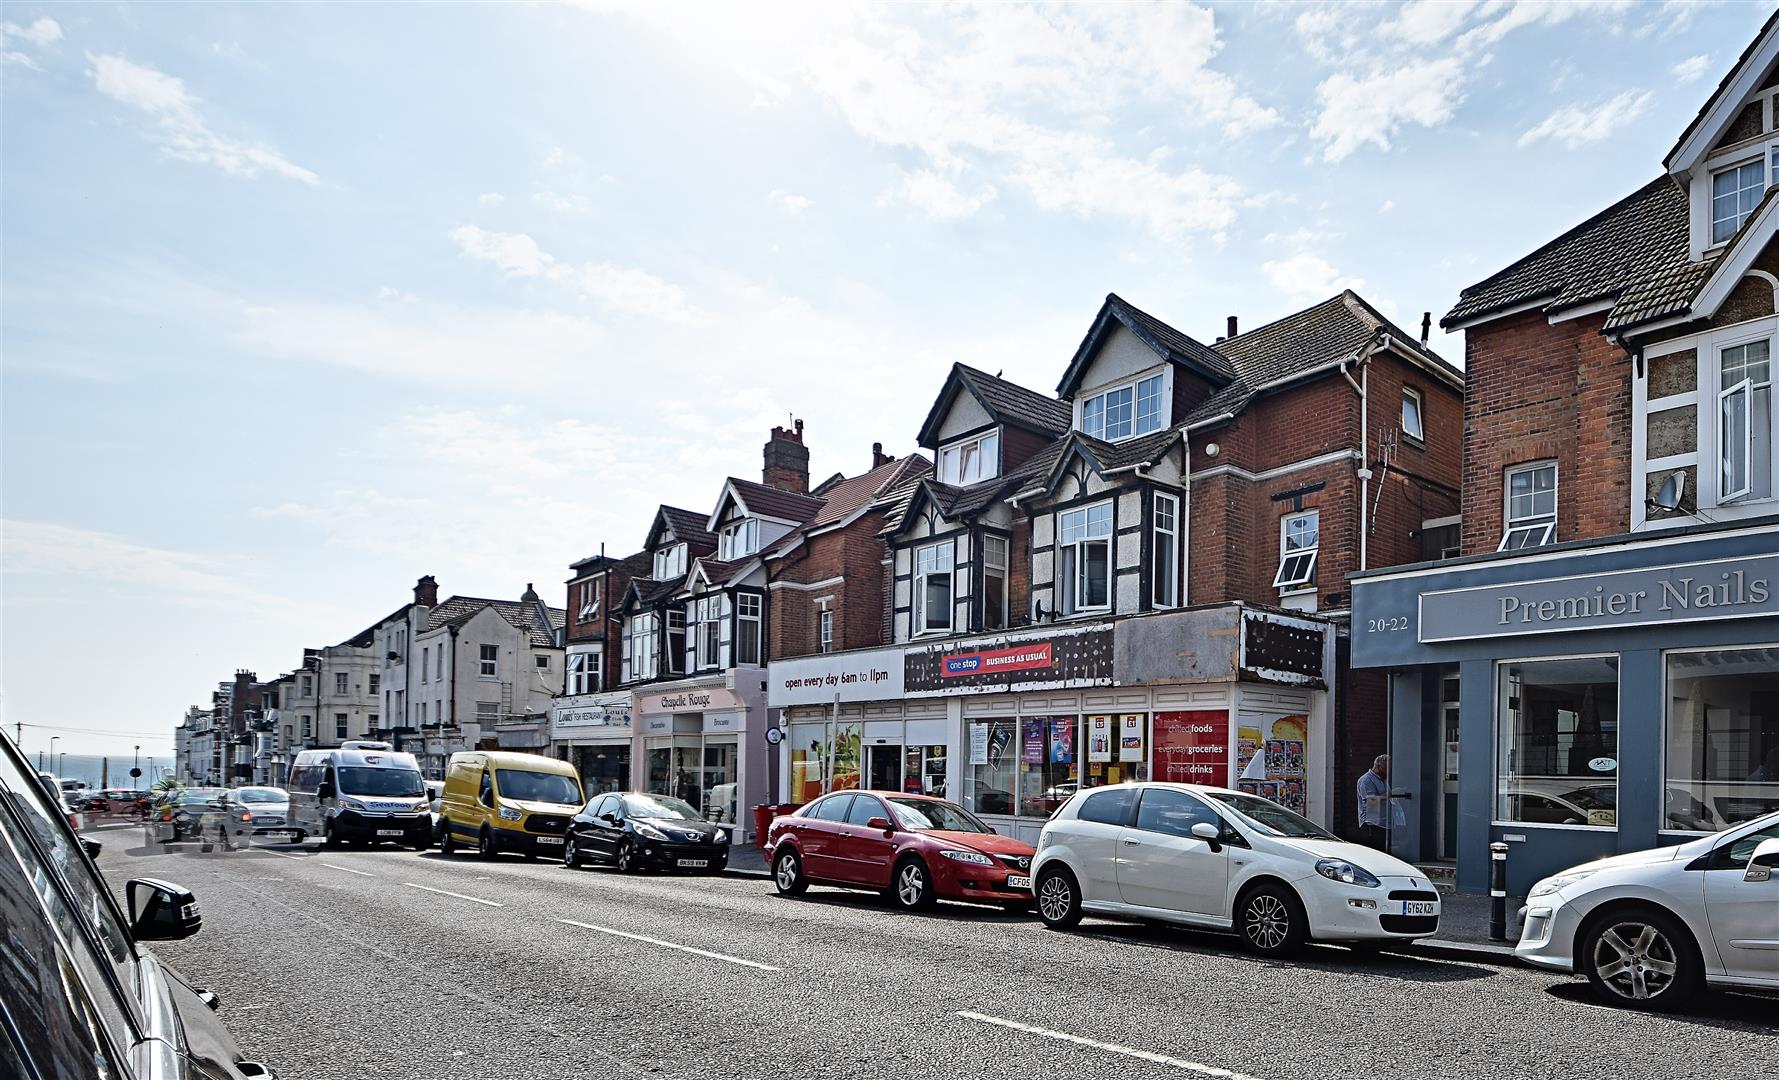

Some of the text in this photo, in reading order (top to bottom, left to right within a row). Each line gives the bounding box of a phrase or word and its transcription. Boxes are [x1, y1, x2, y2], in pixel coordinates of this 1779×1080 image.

[1498, 570, 1769, 625] Premier Nails
[1368, 616, 1408, 633] 20-22
[986, 652, 1047, 666] BUSINESS AS USUAL
[950, 660, 977, 670] one stop
[785, 668, 888, 691] open every day 6am to 11pm
[661, 693, 711, 710] Chapelle Rouge
[1168, 724, 1213, 733] chilled foods
[1158, 744, 1223, 755] everyday groceries
[1167, 764, 1213, 774] chilled drinks
[369, 801, 411, 809] Seafood
[1012, 877, 1030, 887] CF05
[1408, 902, 1423, 914] GY62
